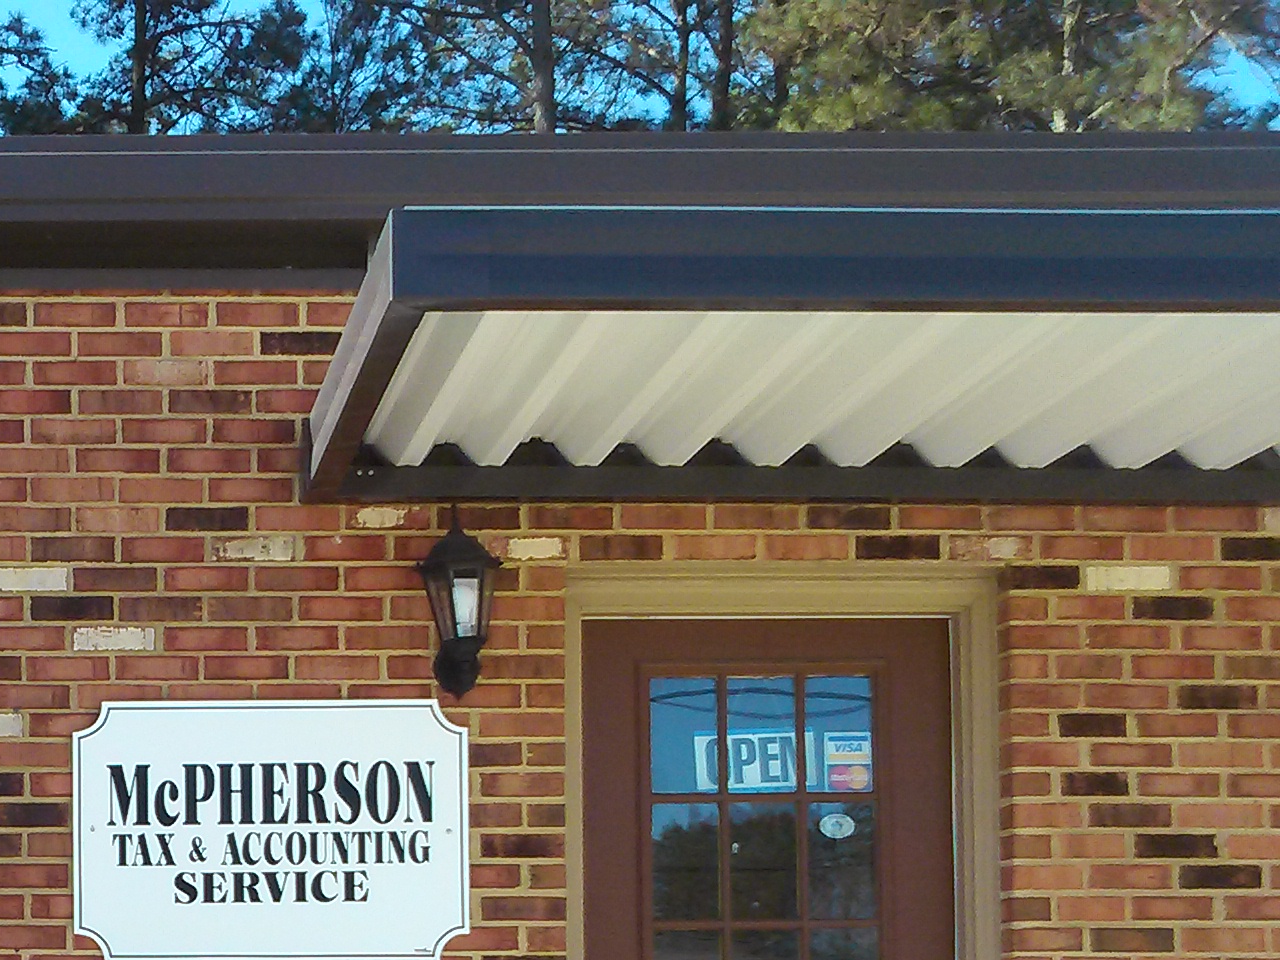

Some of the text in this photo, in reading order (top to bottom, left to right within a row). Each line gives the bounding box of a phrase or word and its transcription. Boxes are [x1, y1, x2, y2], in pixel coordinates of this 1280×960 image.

[833, 742, 863, 753] VISA
[105, 760, 436, 827] McPHERSON
[111, 829, 432, 867] TAX & ACCOUNTING
[173, 869, 370, 904] SERVICE
